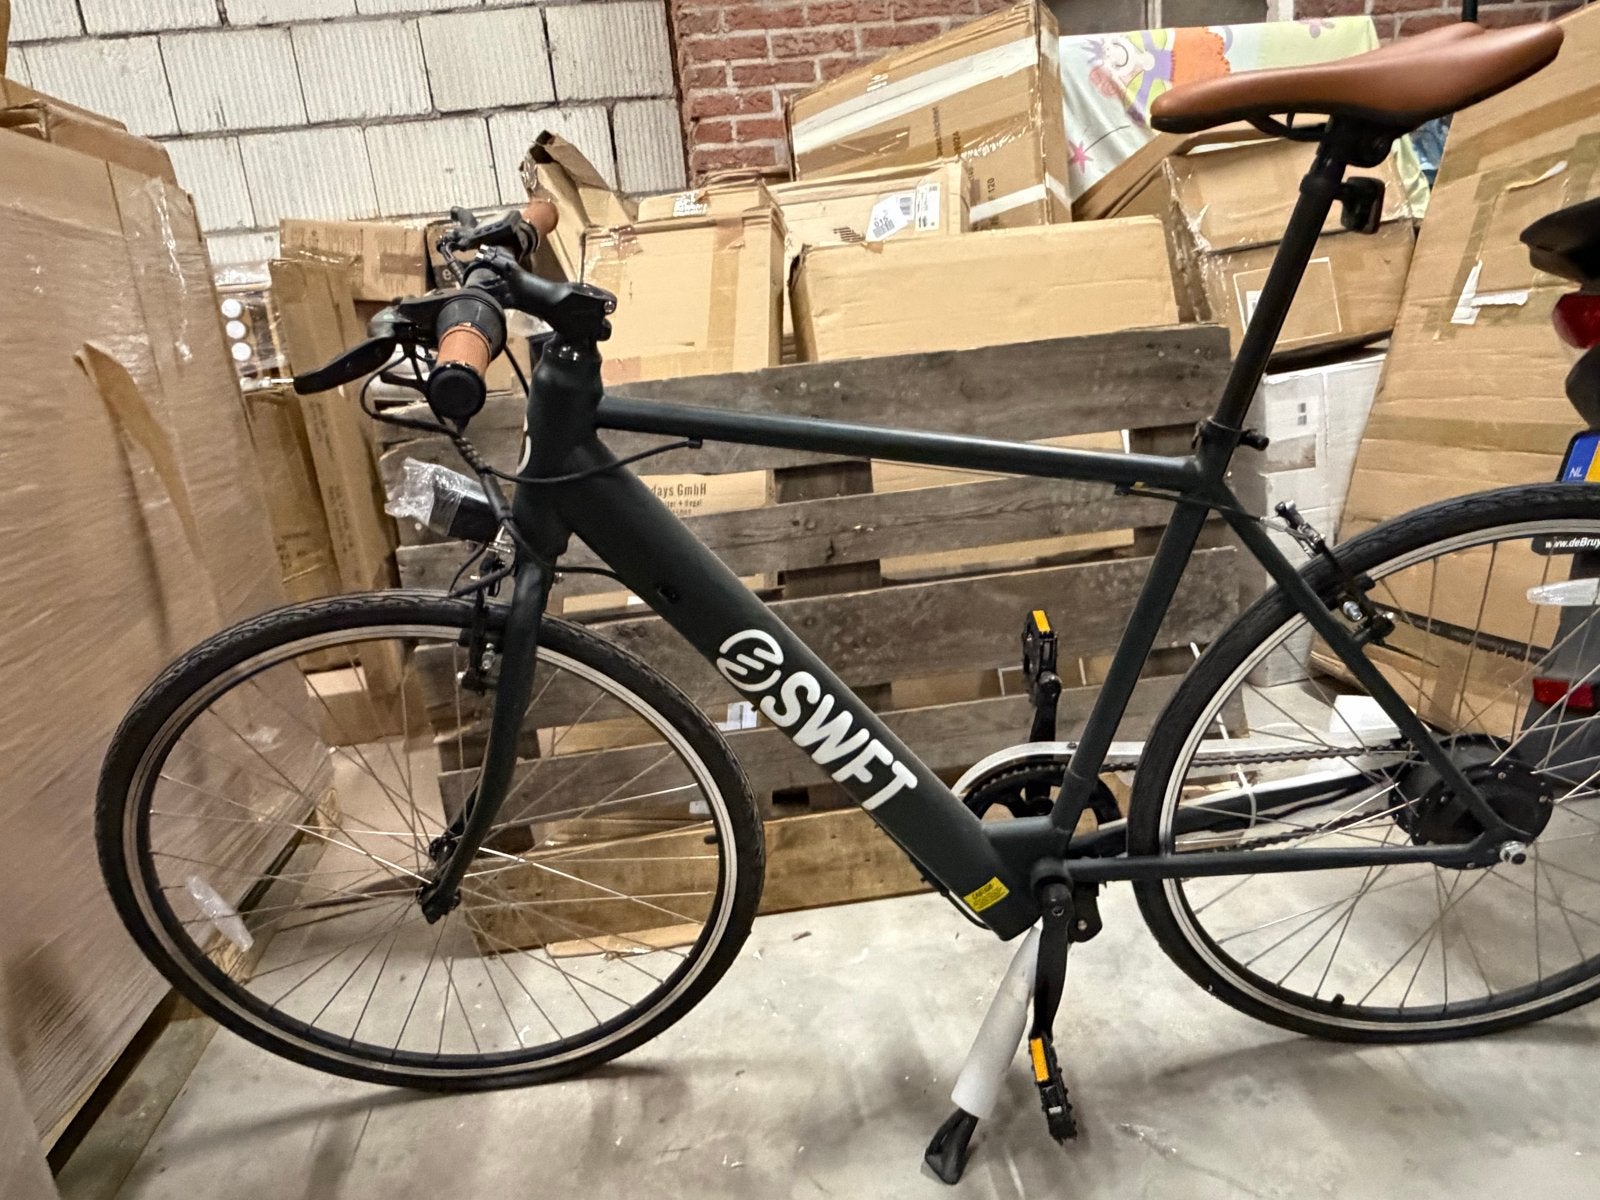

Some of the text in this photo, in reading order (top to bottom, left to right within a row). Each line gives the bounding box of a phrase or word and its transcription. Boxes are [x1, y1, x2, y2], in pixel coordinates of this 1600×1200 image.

[1569, 467, 1582, 478] NL
[677, 483, 706, 496] GmbH
[760, 671, 918, 810] SWFT
